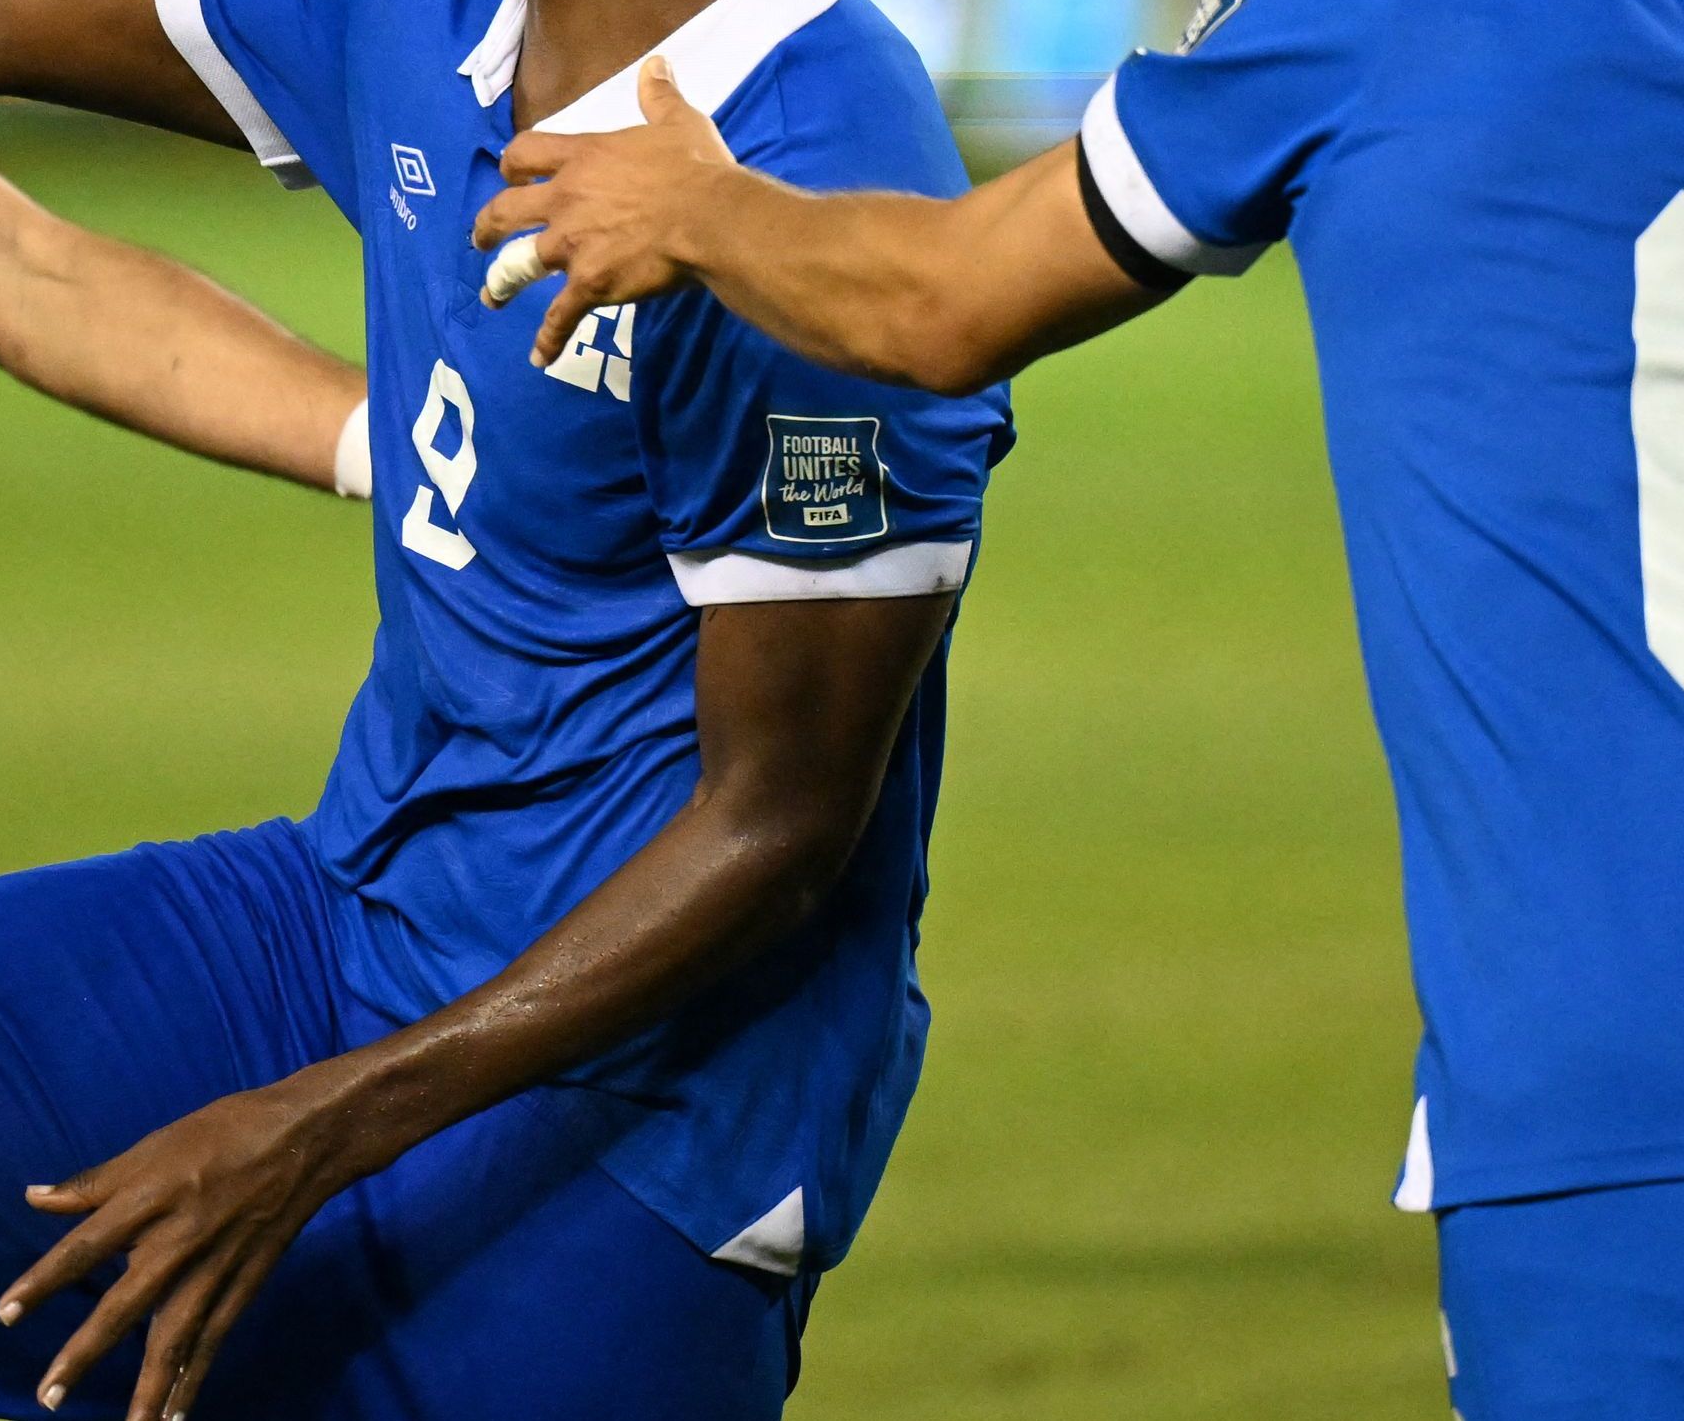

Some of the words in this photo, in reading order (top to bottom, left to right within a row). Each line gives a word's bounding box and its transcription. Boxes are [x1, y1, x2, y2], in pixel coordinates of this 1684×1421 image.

[389, 182, 417, 231] umbro
[782, 435, 861, 455] FOOTBALL
[402, 358, 478, 570] 9
[783, 455, 861, 481] UNITES
[778, 482, 811, 502] the
[813, 476, 866, 503] World
[809, 509, 843, 522] FIFA
